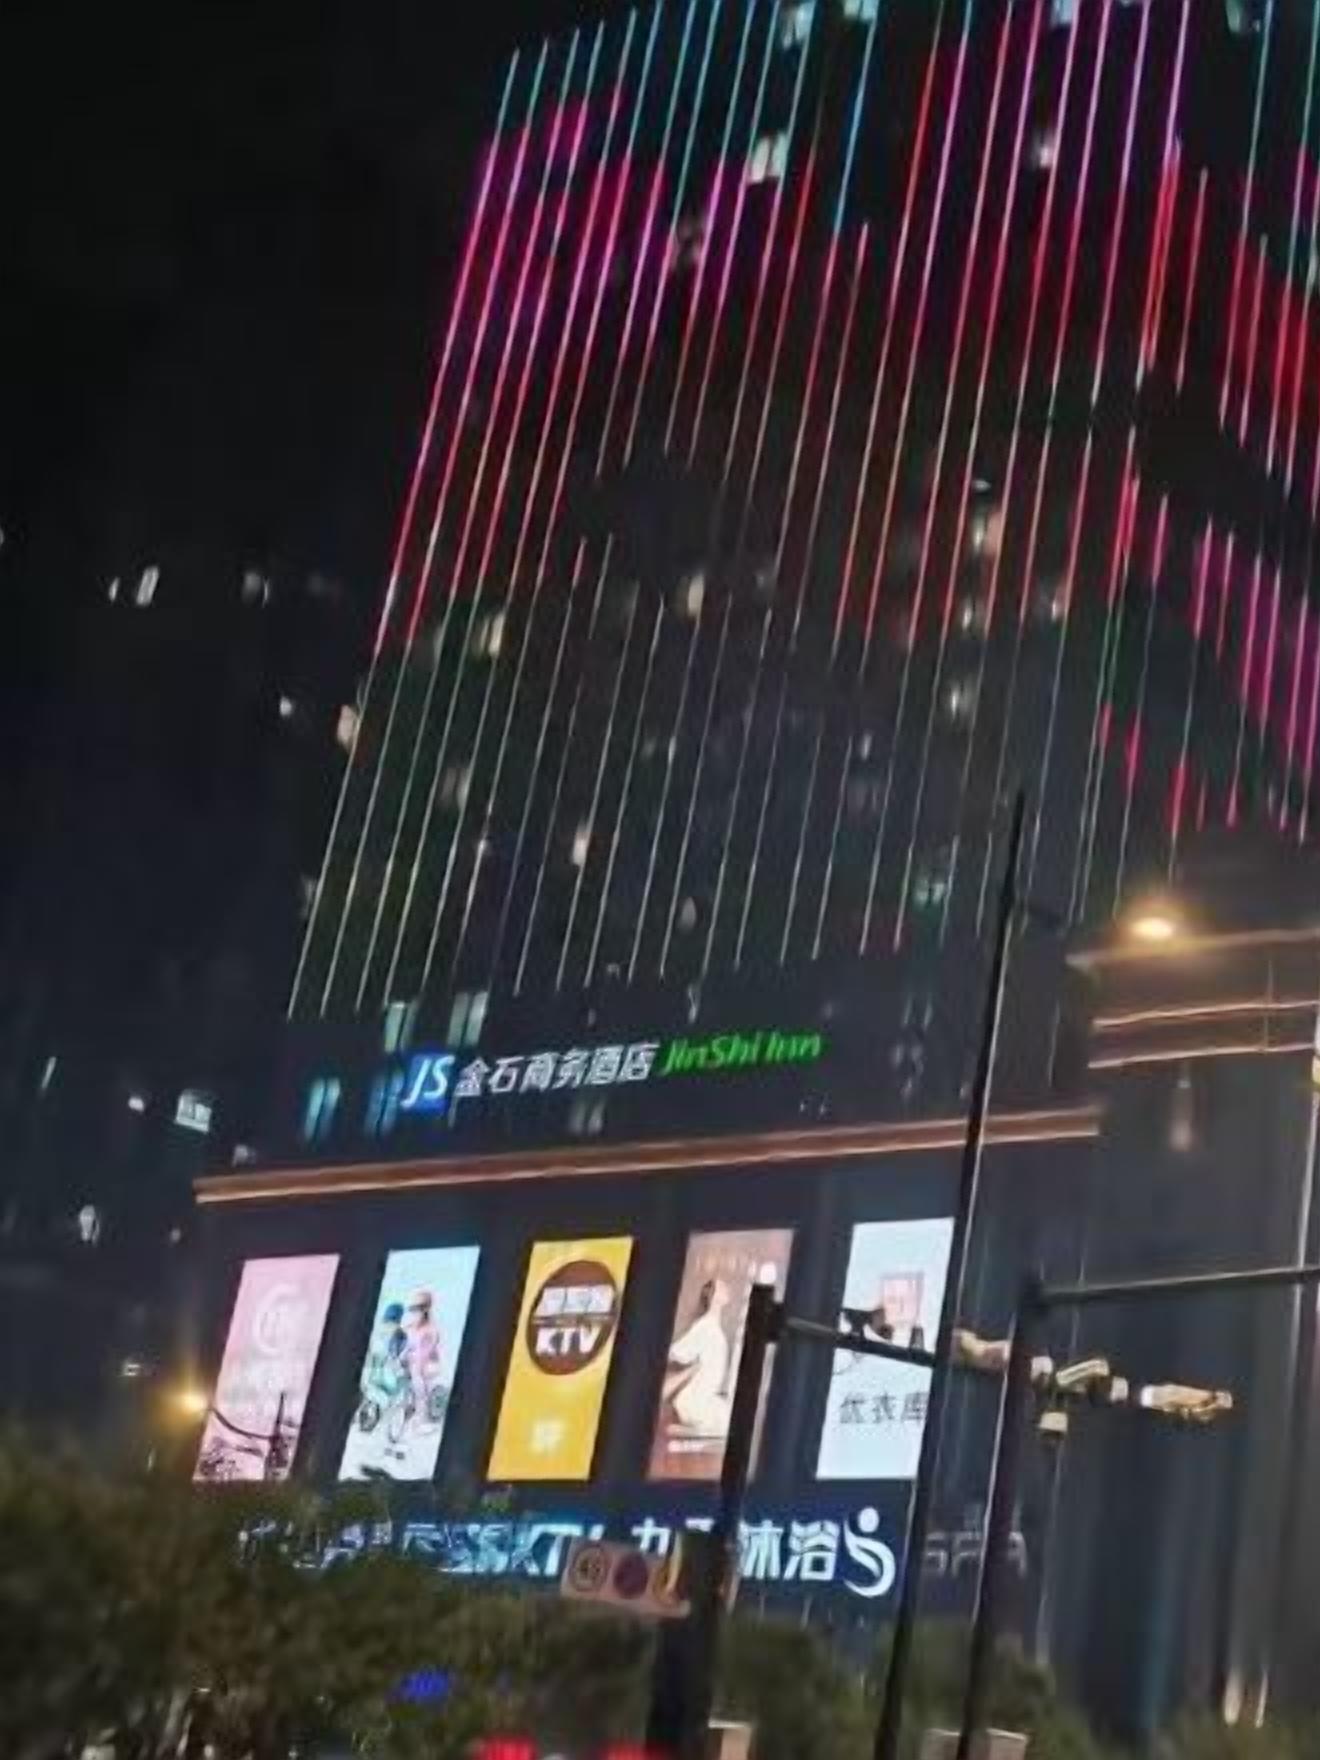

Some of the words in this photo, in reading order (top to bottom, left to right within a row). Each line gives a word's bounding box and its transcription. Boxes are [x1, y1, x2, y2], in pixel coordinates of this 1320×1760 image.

[454, 1042, 661, 1098] 金石商务酒店
[535, 1324, 602, 1354] KTV
